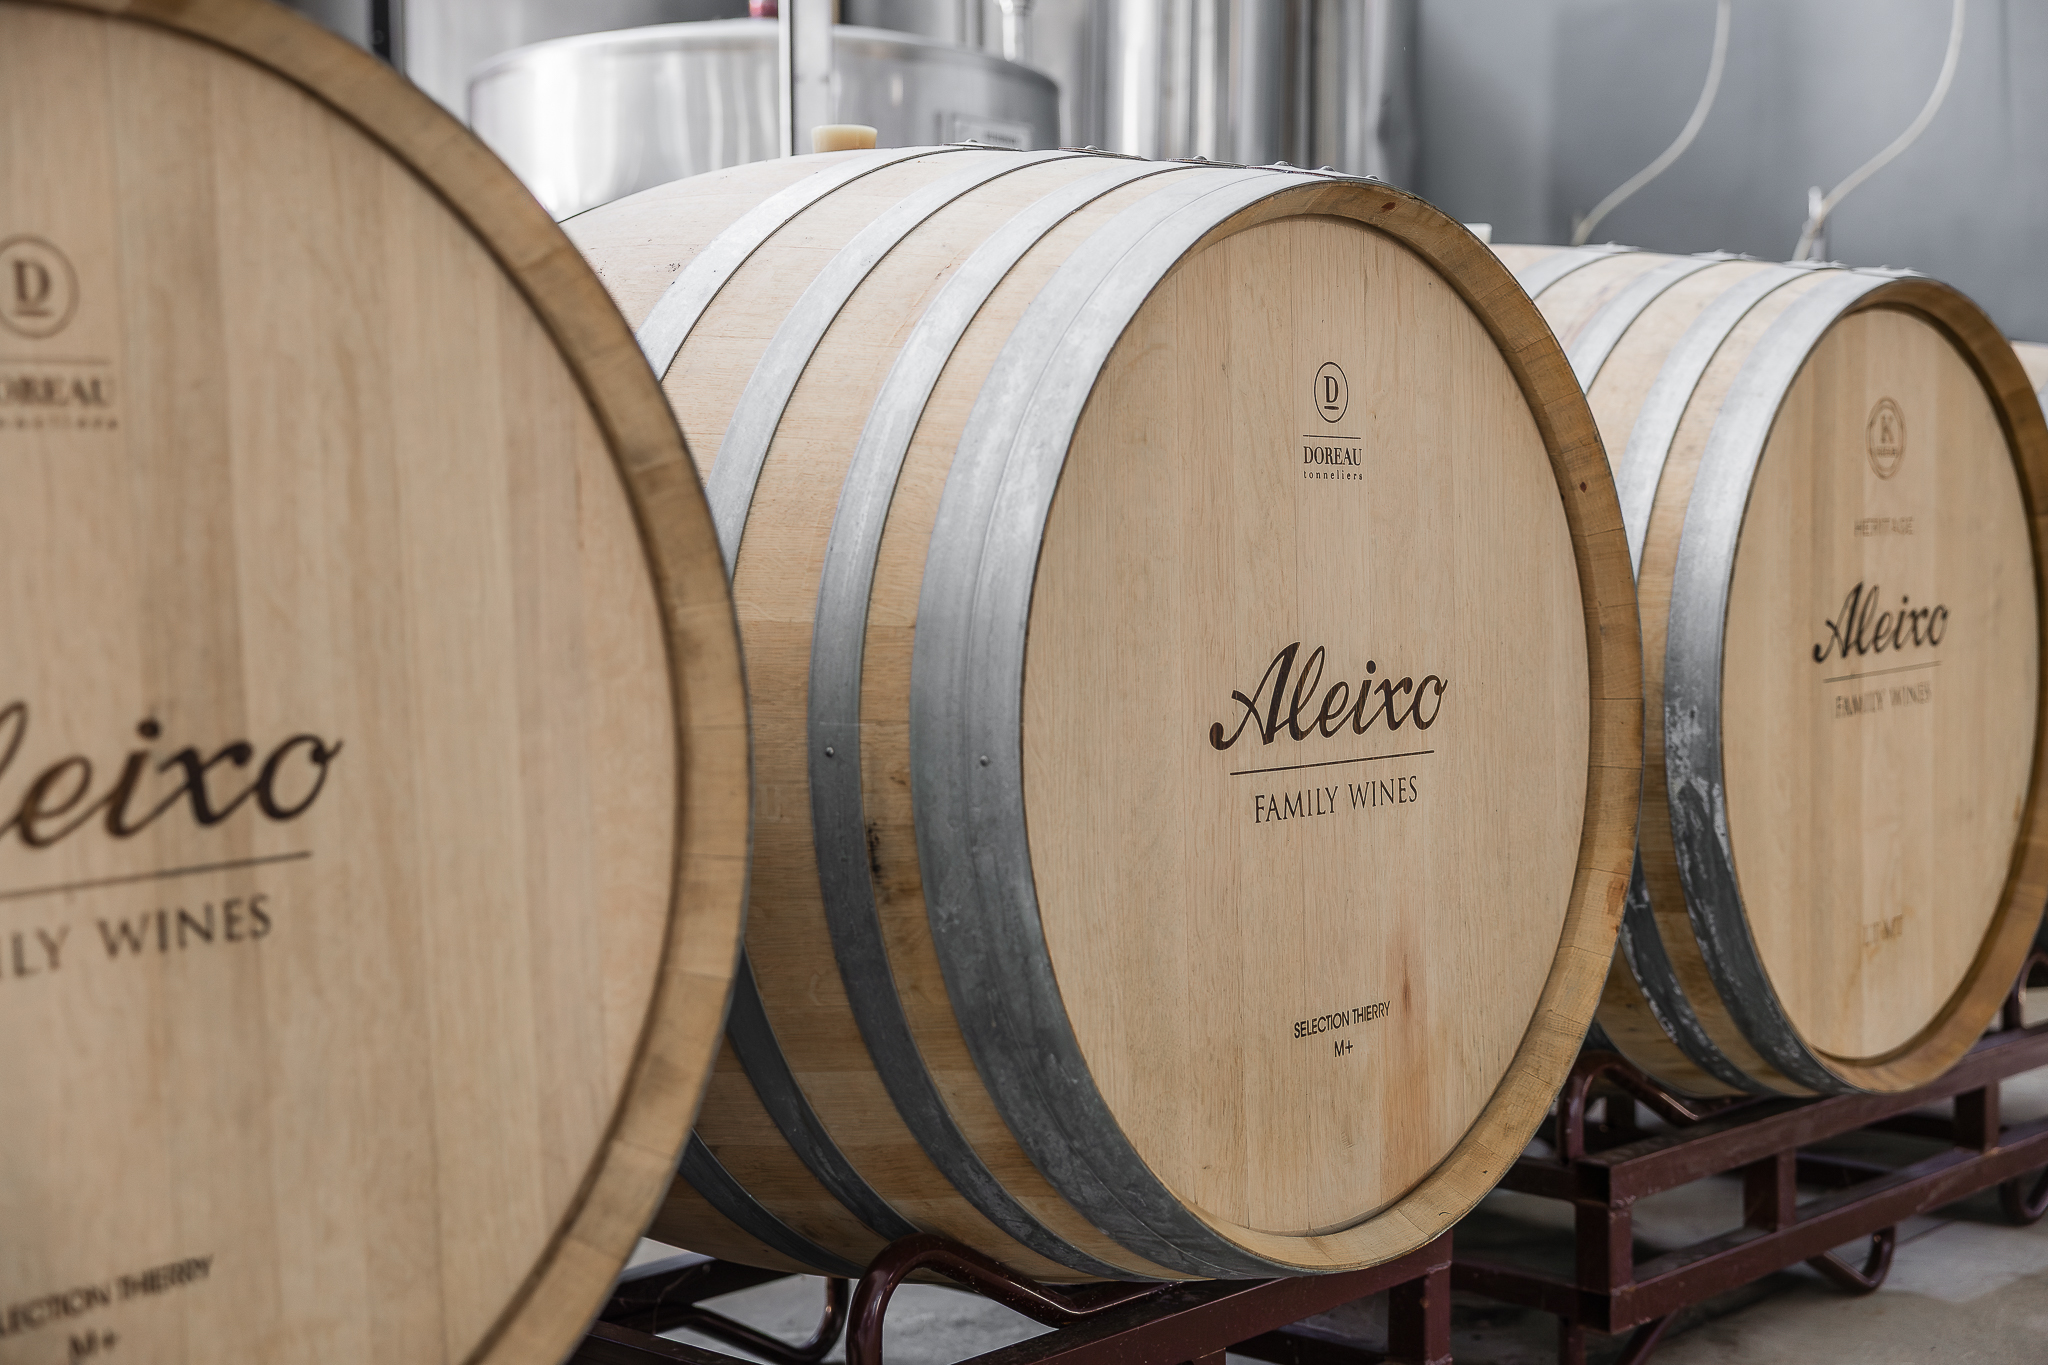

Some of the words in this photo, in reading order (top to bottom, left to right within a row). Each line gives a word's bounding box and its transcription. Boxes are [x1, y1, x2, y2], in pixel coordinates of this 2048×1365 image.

[1323, 375, 1339, 403] D
[1303, 445, 1363, 466] DOREAU
[1303, 470, 1363, 481] tonneliers
[1812, 580, 1950, 664] Aleixo
[1209, 641, 1449, 751] Aleixo
[1254, 785, 1339, 824] FAMILY
[1347, 775, 1418, 810] WINES
[97, 894, 272, 961] WINES
[1294, 1010, 1350, 1039] SELECTION
[1352, 1000, 1391, 1025] THIERRY
[1334, 1039, 1354, 1058] M+
